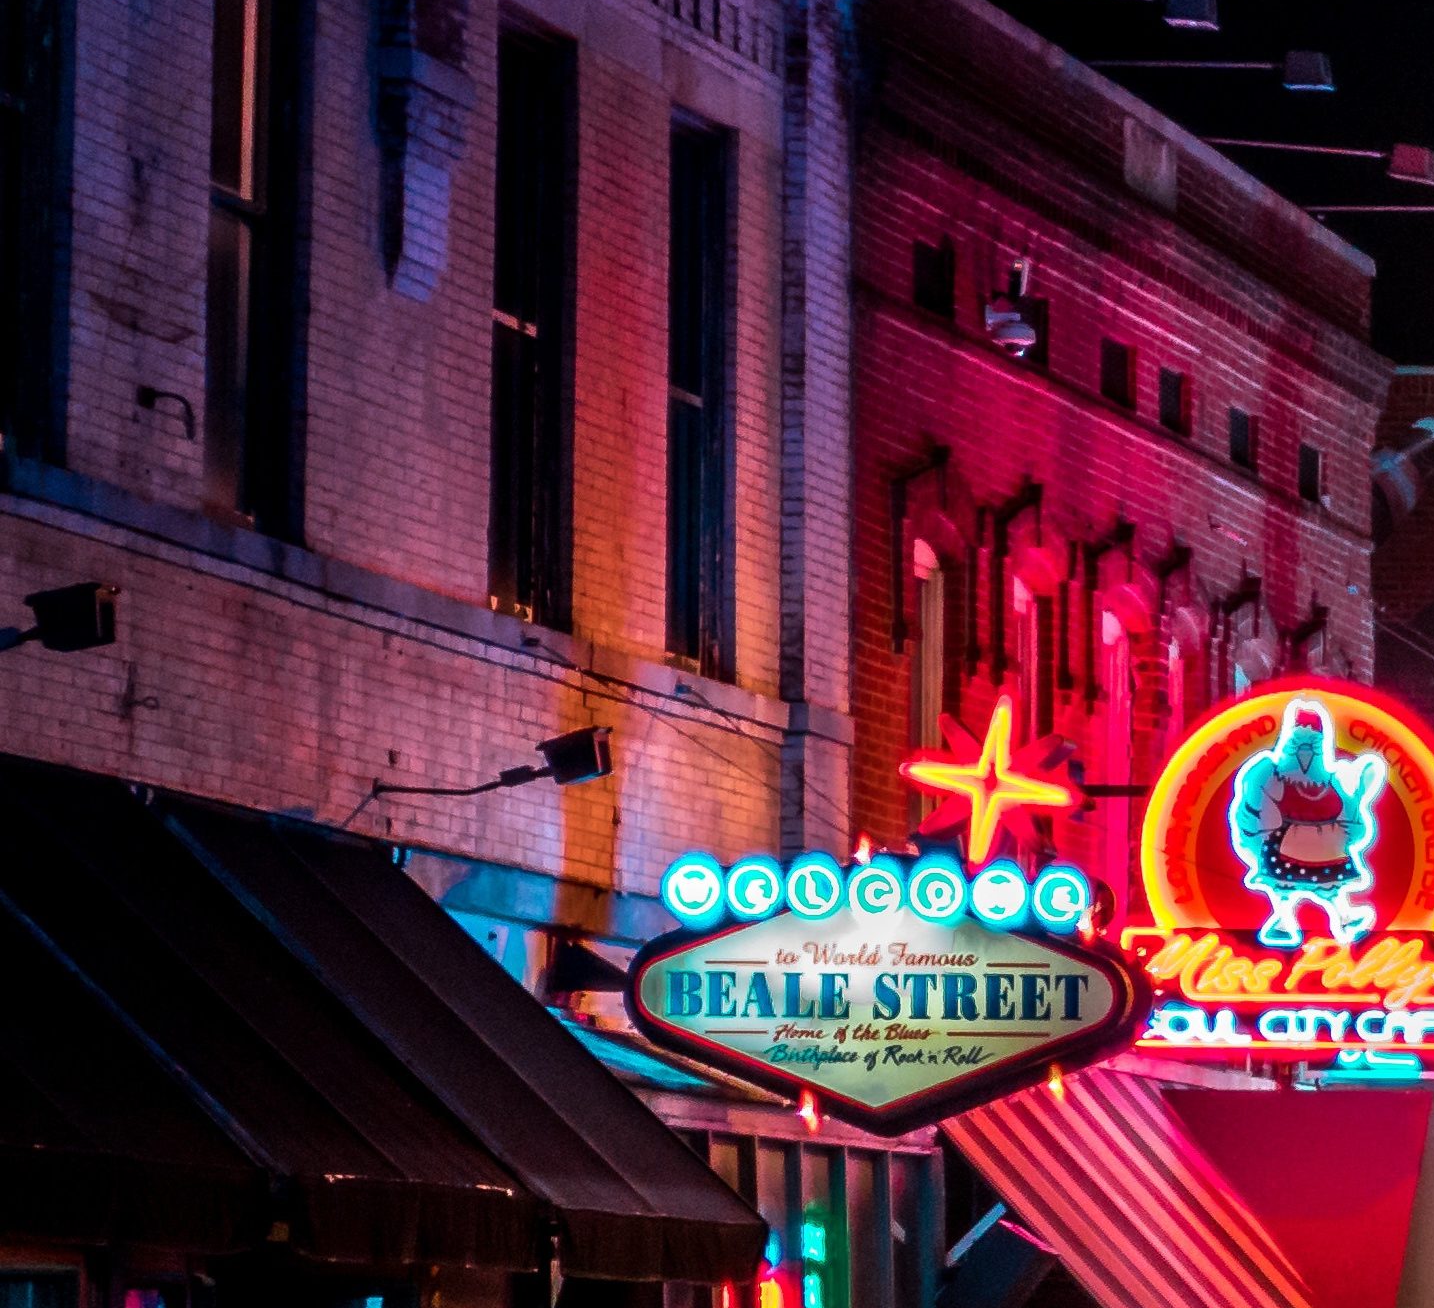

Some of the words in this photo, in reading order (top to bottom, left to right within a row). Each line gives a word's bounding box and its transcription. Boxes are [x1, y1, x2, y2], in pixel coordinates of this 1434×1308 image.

[775, 945, 800, 967] to
[800, 940, 880, 968] World
[887, 941, 979, 969] Famous
[1145, 934, 1282, 993] Miss
[665, 970, 850, 1020] BEALE
[872, 971, 1090, 1022] STREET
[773, 1022, 827, 1044] Home
[832, 1022, 849, 1044] of
[852, 1023, 881, 1041] the
[884, 1023, 933, 1043] Blues
[1259, 1009, 1351, 1042] CITY
[766, 1044, 858, 1071] Birthplace
[863, 1045, 880, 1070] of
